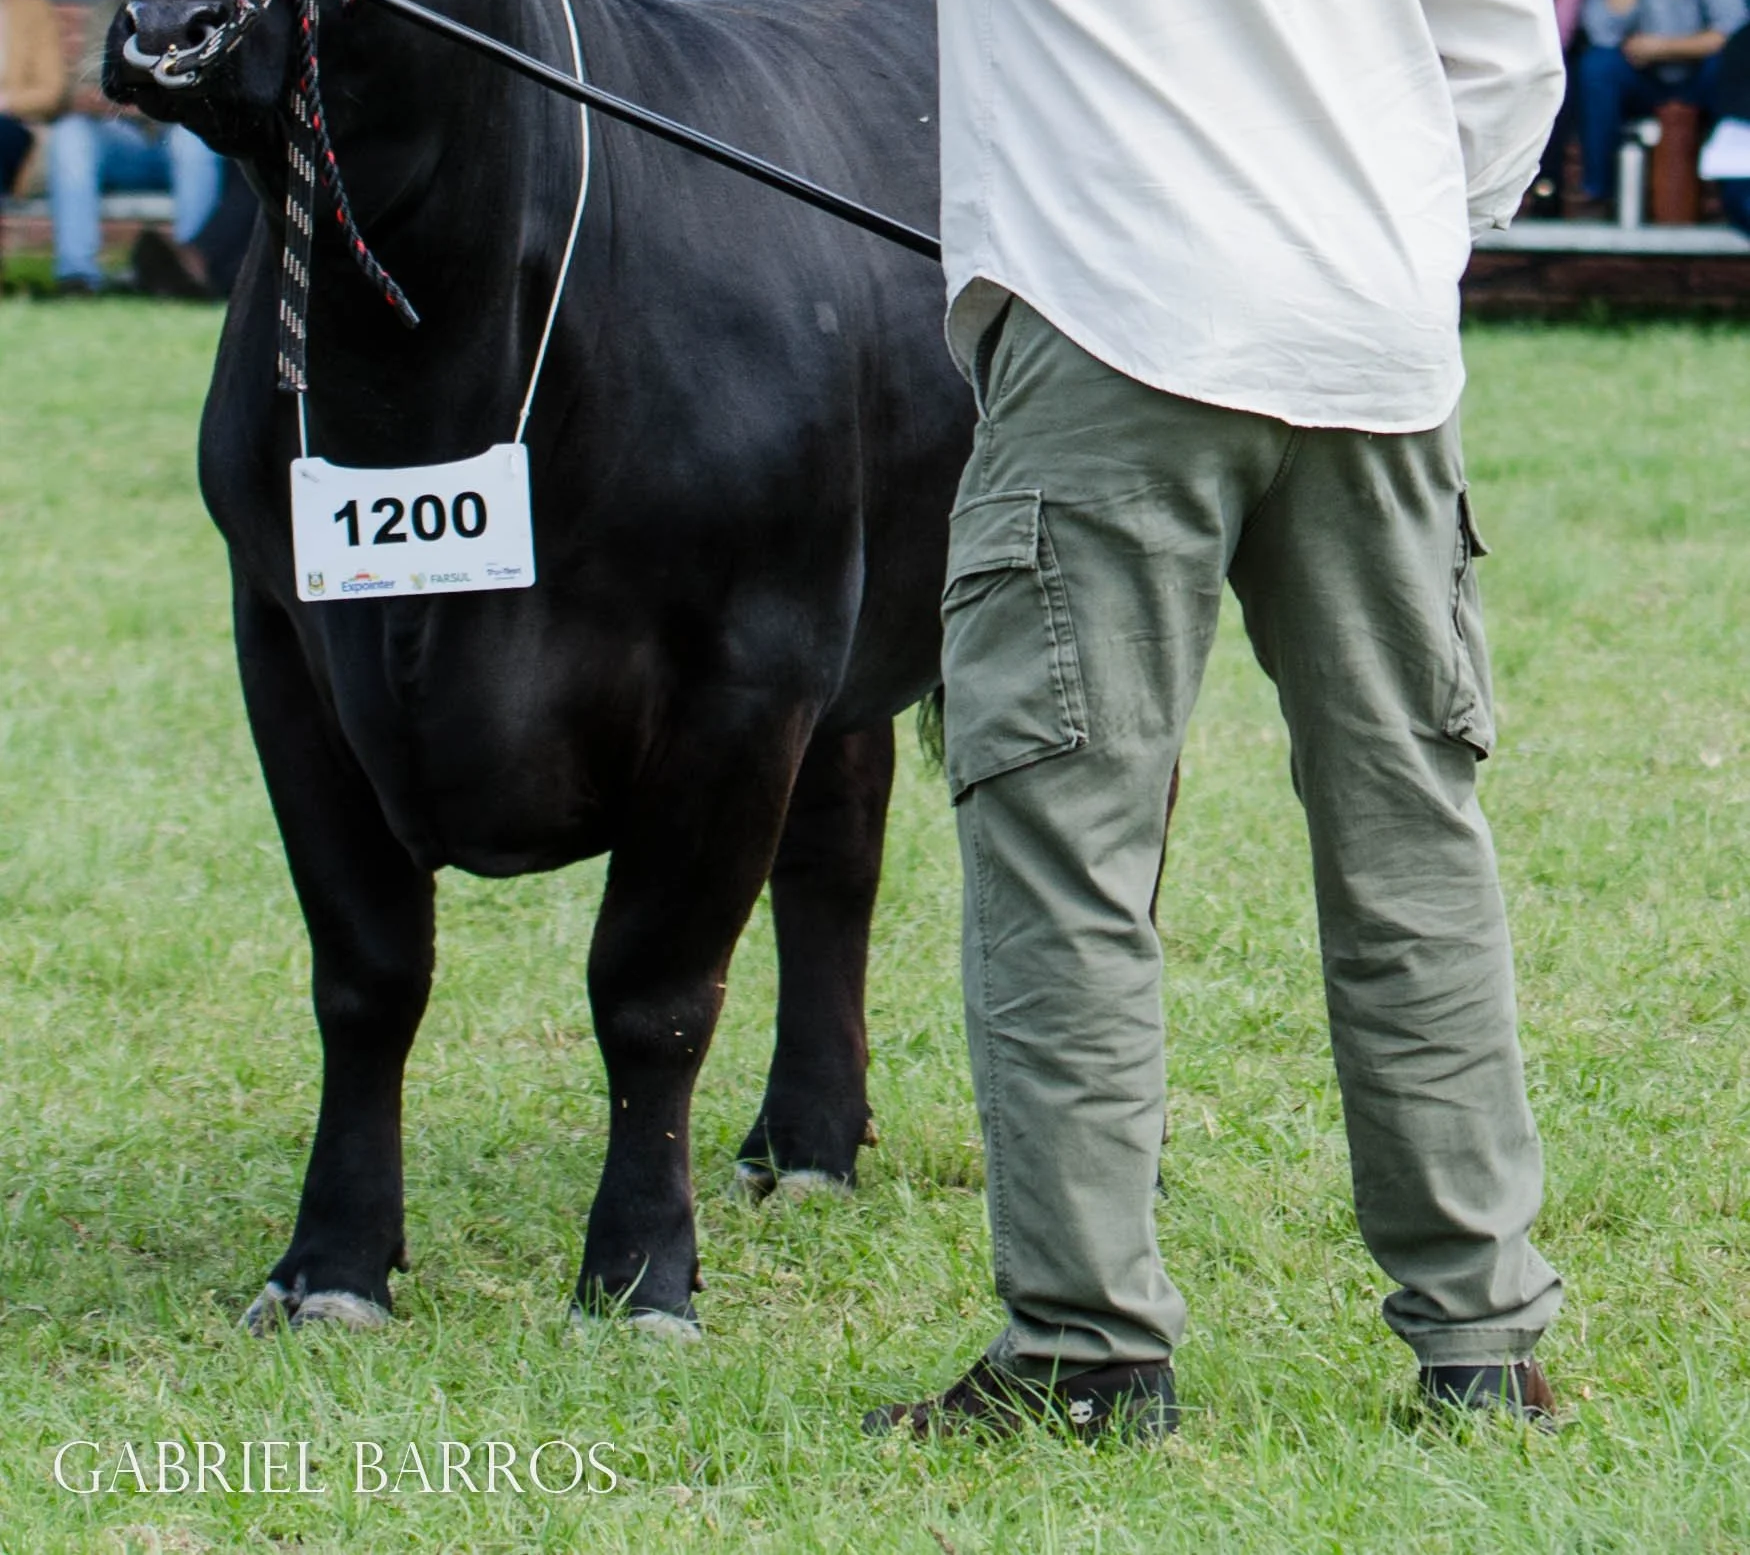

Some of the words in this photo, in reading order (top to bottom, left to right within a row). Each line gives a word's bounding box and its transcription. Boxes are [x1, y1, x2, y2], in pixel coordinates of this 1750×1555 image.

[333, 491, 487, 546] 1200
[430, 572, 472, 584] FARSUL
[341, 580, 396, 593] Expointer
